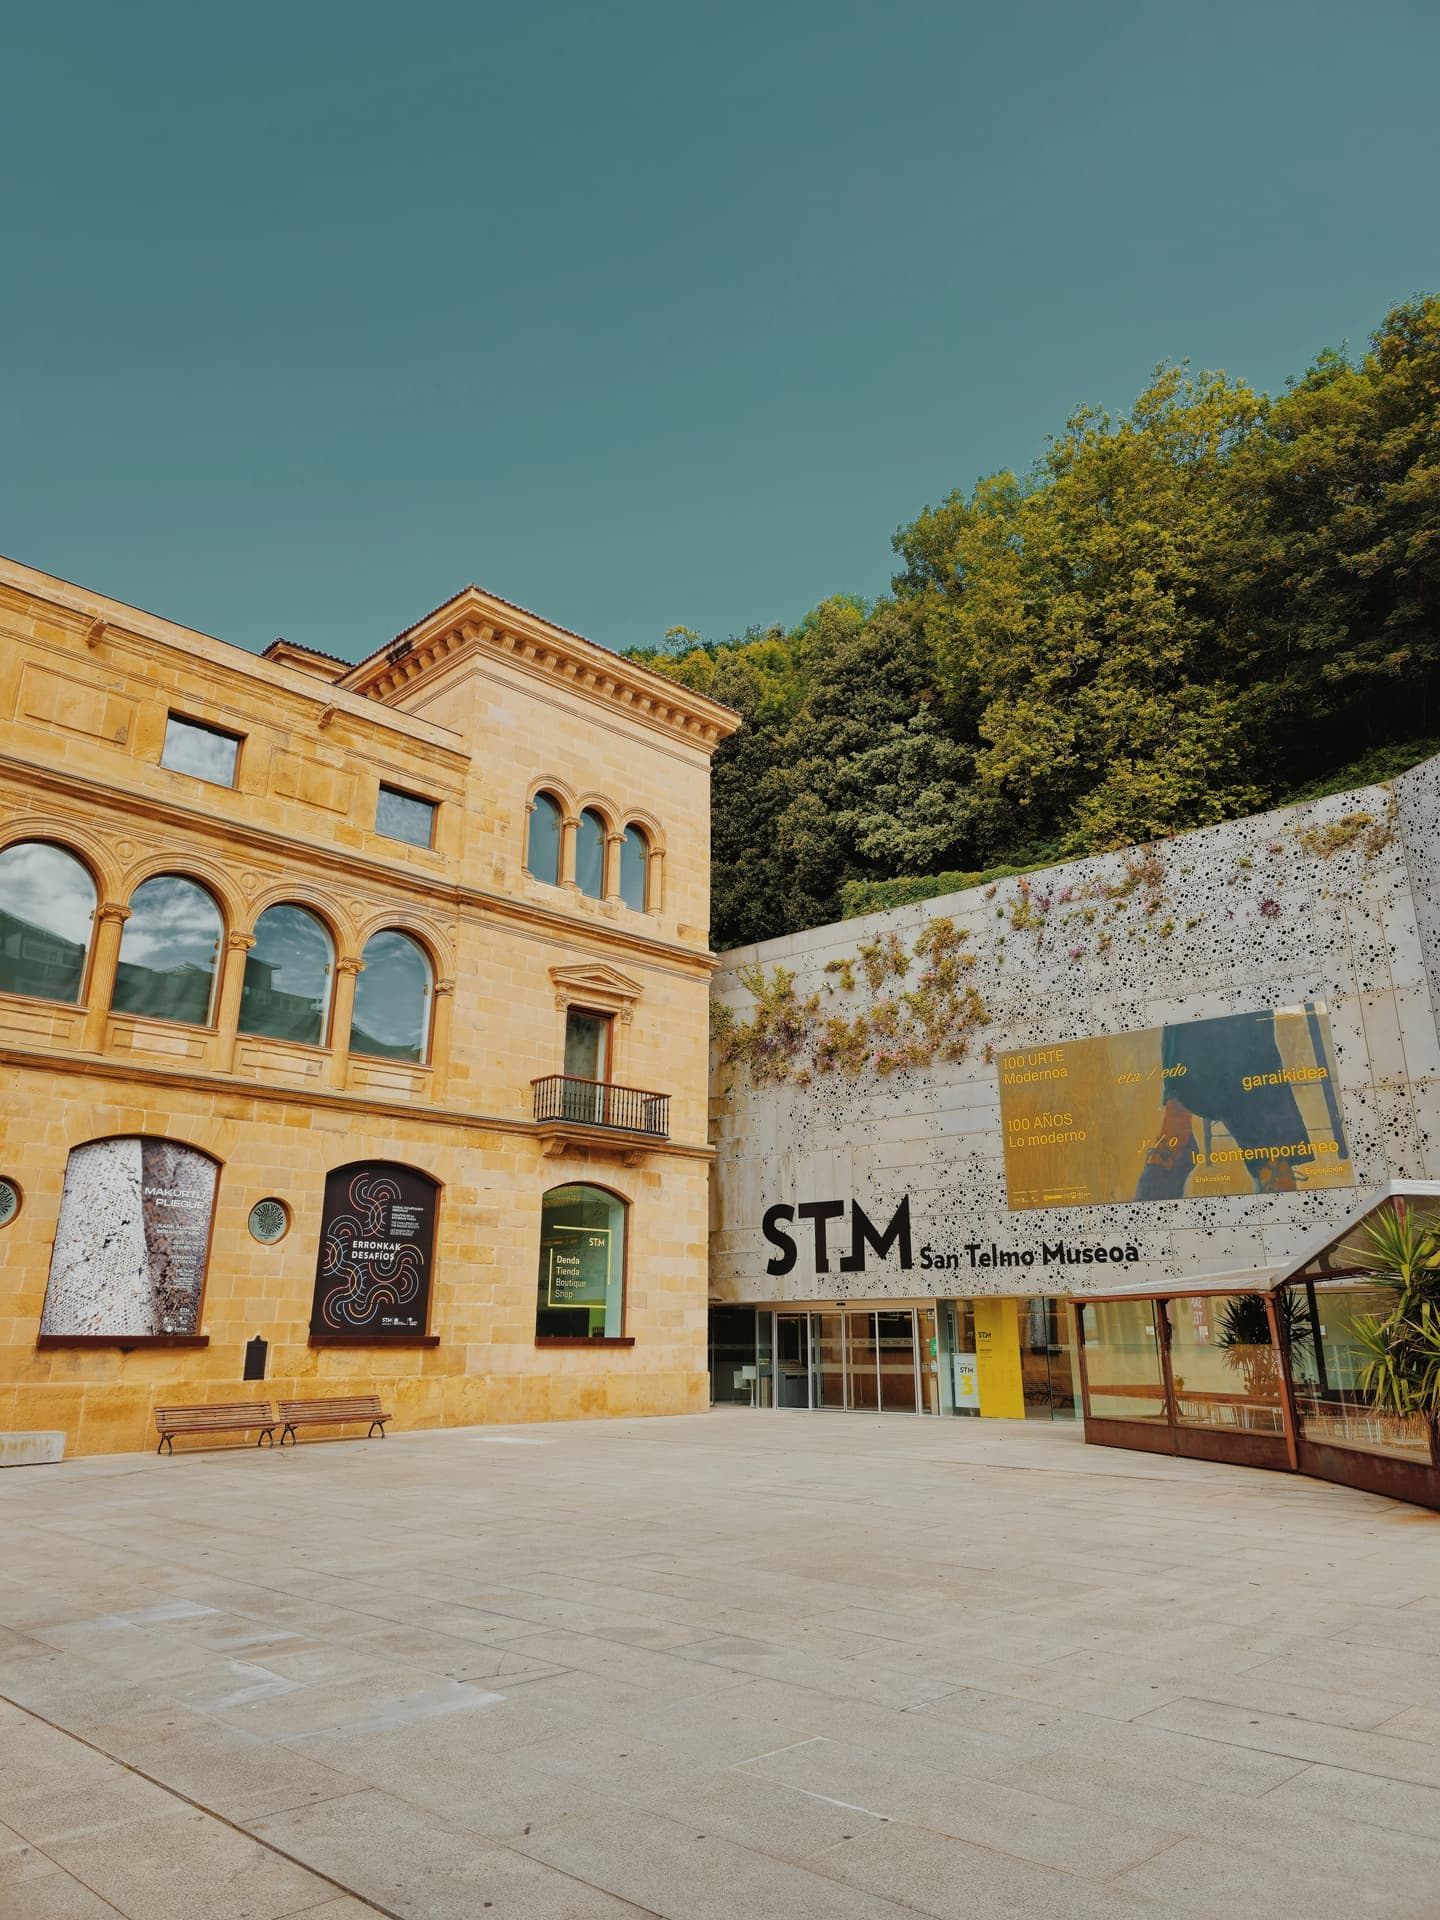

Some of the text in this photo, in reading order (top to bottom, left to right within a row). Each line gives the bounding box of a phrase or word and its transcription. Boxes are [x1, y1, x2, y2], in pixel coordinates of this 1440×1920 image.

[1004, 1049, 1065, 1070] 100 URTE
[1004, 1067, 1068, 1085] Modernoa
[1117, 1071, 1142, 1085] eta
[1160, 1063, 1187, 1079] edo
[1242, 1066, 1328, 1091] garaikidea
[1008, 1111, 1073, 1132] 100 AÑOS
[1009, 1130, 1087, 1148] Lo moderno
[1138, 1137, 1151, 1153] y
[1168, 1136, 1178, 1147] o
[1191, 1141, 1339, 1164] lo contemporáneo
[589, 1237, 605, 1247] STM
[762, 1194, 1140, 1276] STM San Telmo Museoa
[352, 1240, 400, 1251] ERRONKAK
[351, 1250, 395, 1261] DESAFÍOS
[556, 1255, 580, 1265] Denda
[556, 1266, 580, 1276] Tienda
[555, 1277, 586, 1288] Boutique
[555, 1289, 573, 1299] Shop
[978, 1331, 992, 1339] STM
[960, 1366, 974, 1374] STM
